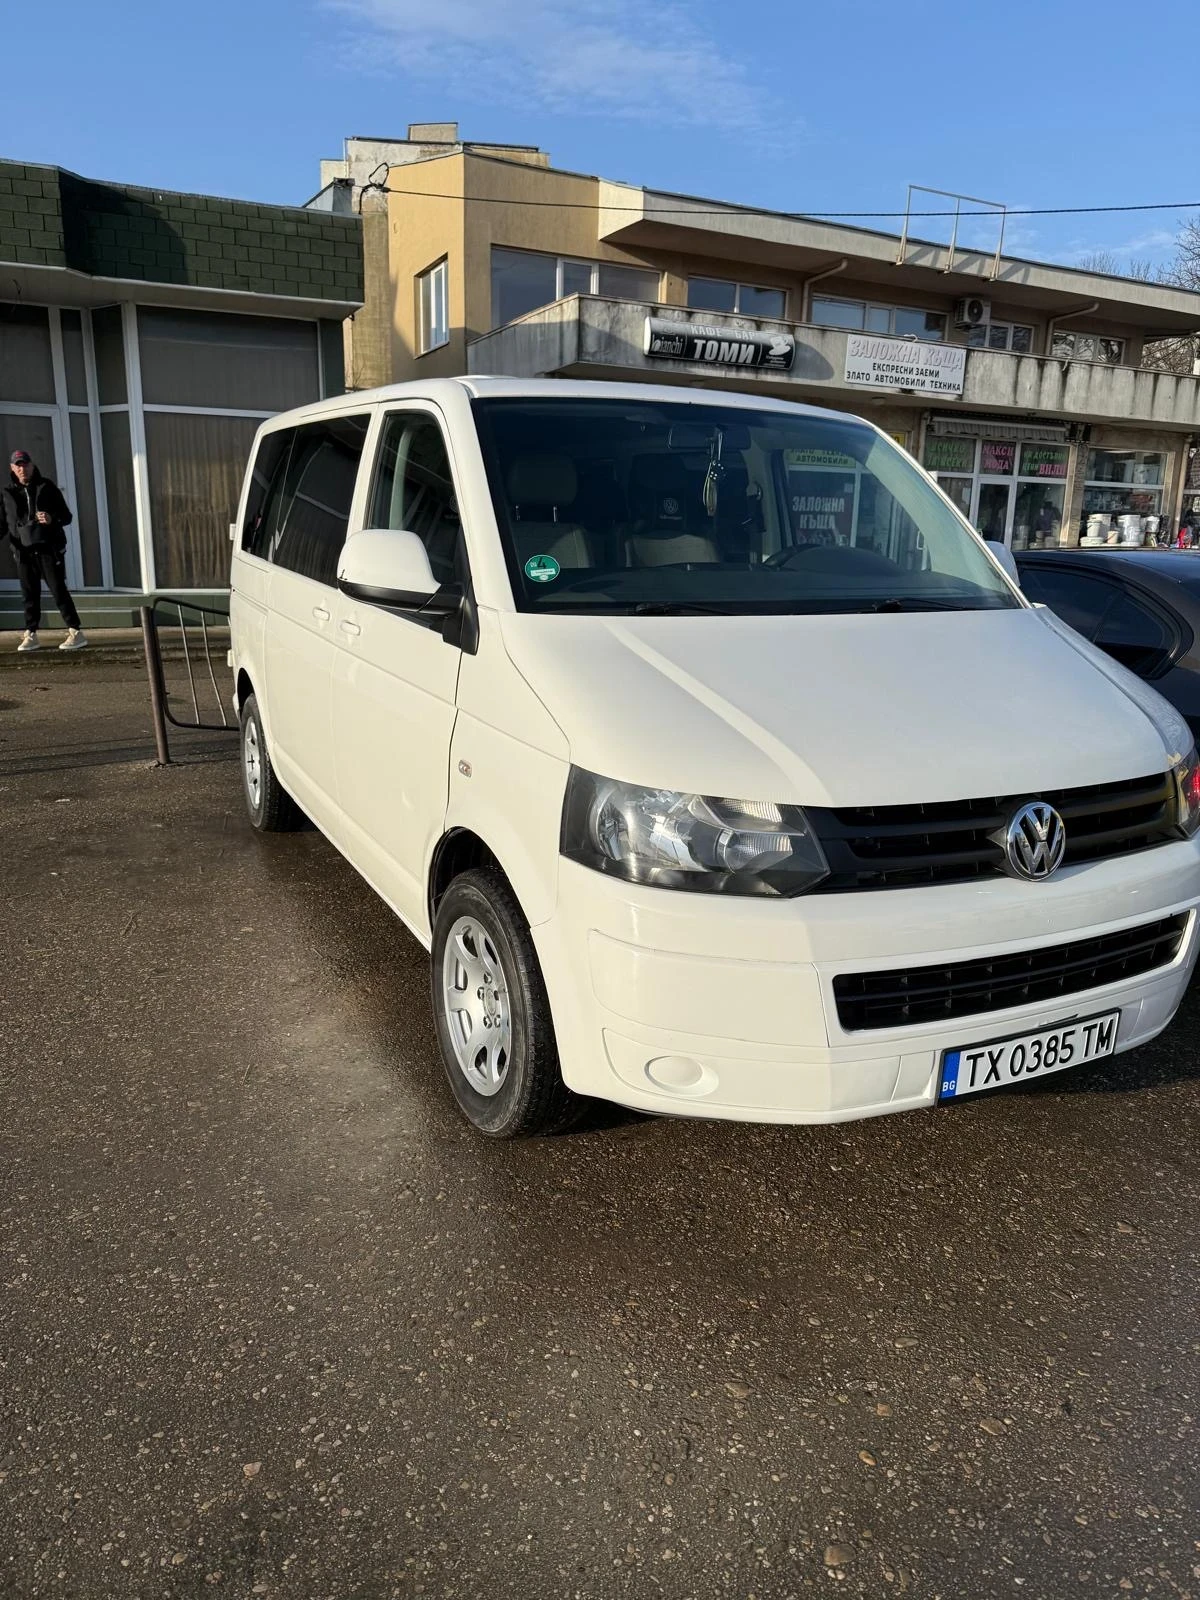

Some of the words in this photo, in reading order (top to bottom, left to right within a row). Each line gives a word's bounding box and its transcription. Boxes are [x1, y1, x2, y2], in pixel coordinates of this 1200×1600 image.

[691, 325, 723, 337] КАФЕ
[735, 330, 755, 340] БАР
[693, 339, 755, 363] ТОМИ
[850, 339, 920, 364] ЗАЛОЖНА
[923, 349, 964, 372] КЪЩА
[872, 363, 914, 375] ЕКСПРЕСНИ
[915, 367, 940, 379] ЗАЕМИ
[846, 371, 871, 381] ЗЛАТО
[875, 375, 926, 388] АВТОМОБИЛИ
[930, 381, 961, 391] ТЕХНИКА
[983, 444, 1014, 457] МАКСИ
[983, 459, 1009, 470] МОДА
[792, 496, 845, 512] ЗАЛОЖНА
[537, 557, 547, 569] 4
[966, 1048, 1005, 1087] TX
[1009, 1030, 1076, 1077] 0385
[1082, 1019, 1114, 1058] TM
[942, 1080, 956, 1092] BG
